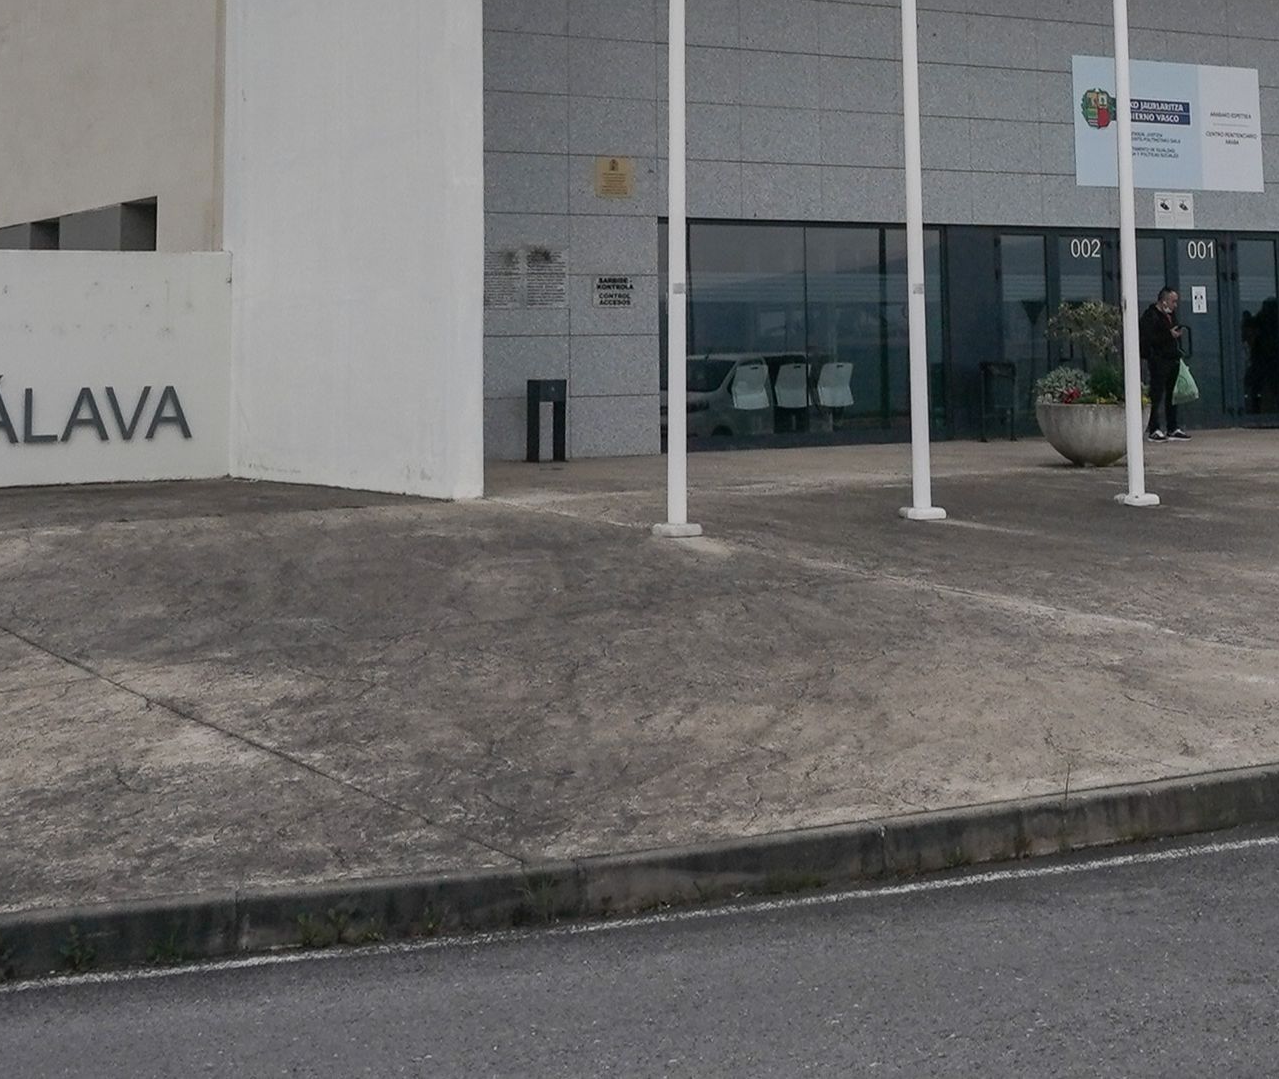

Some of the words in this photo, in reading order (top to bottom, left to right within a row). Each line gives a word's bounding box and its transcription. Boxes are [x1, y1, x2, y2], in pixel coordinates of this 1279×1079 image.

[1132, 112, 1155, 121] IERNO
[1155, 114, 1179, 123] VASCO
[1071, 238, 1101, 258] 002
[1187, 240, 1214, 259] 001
